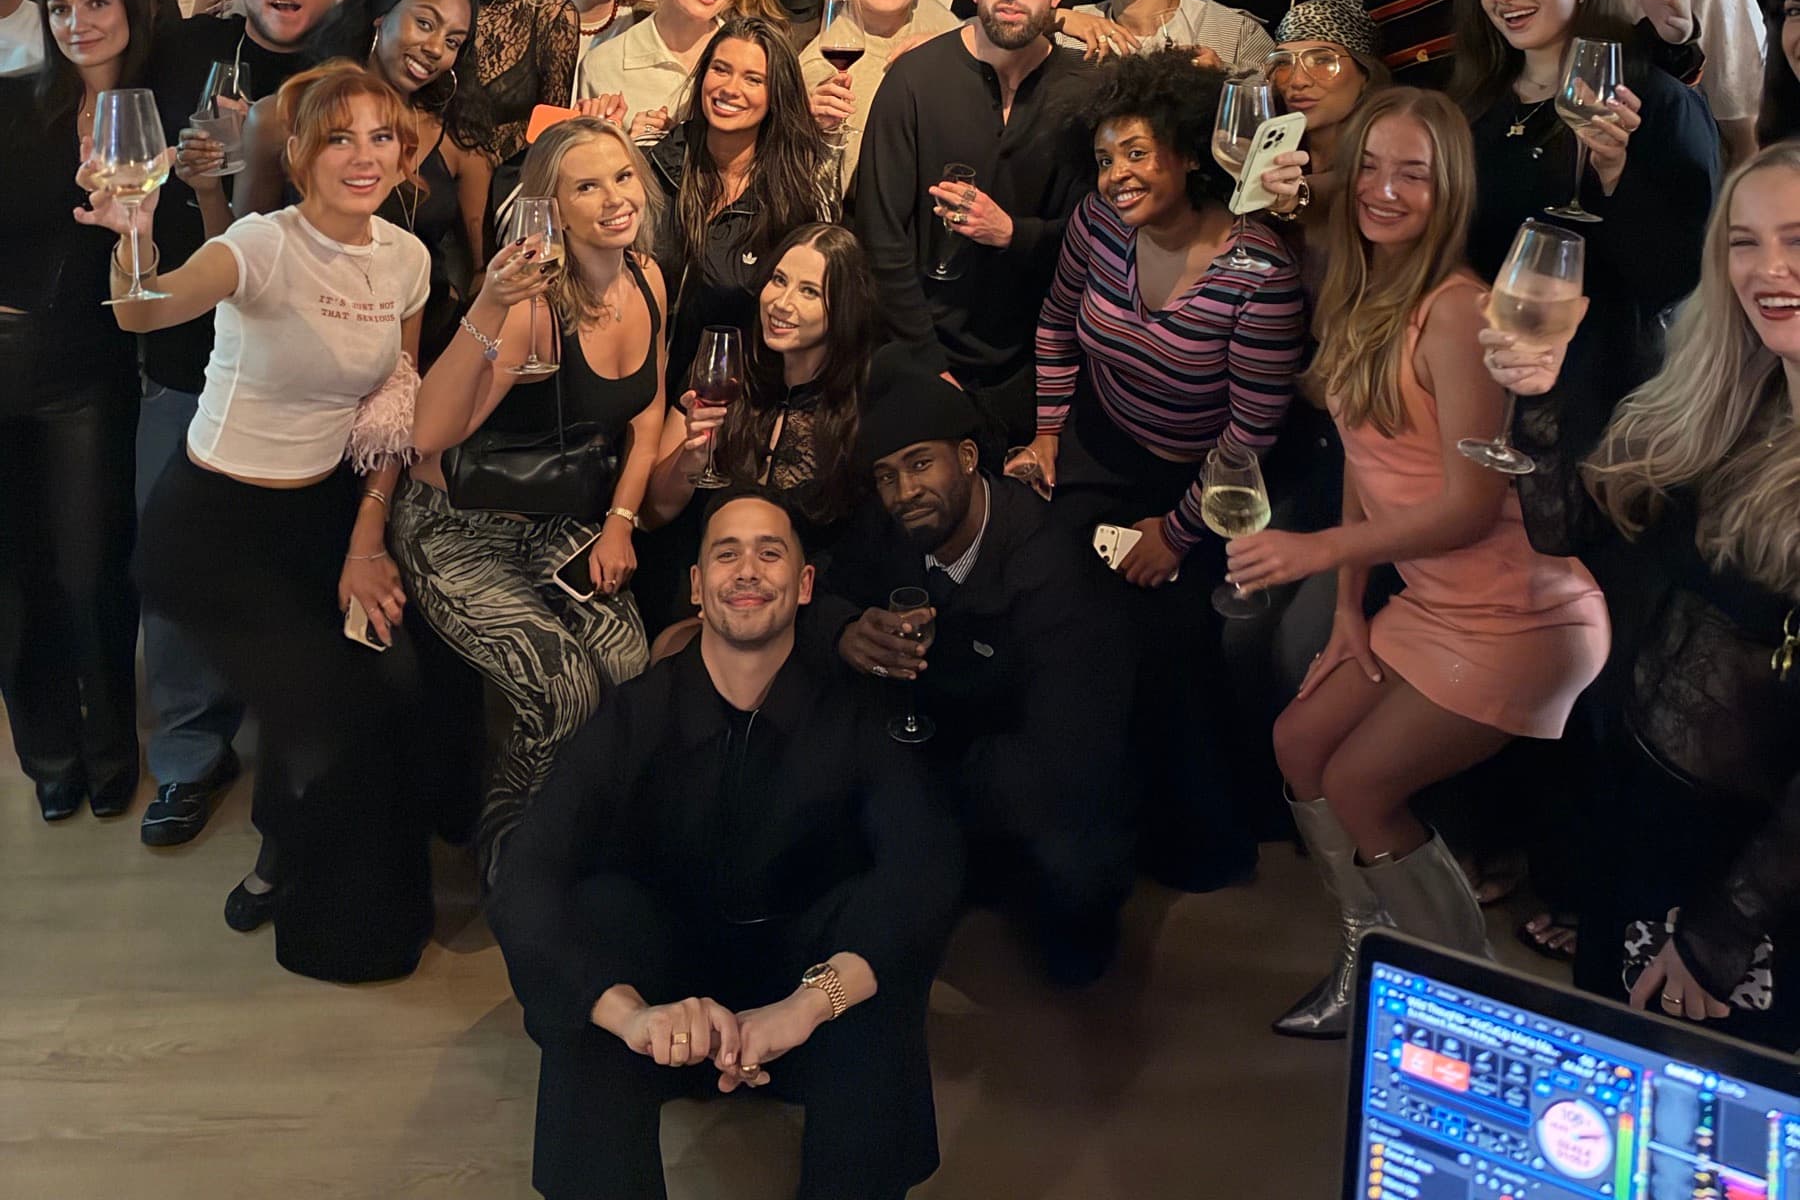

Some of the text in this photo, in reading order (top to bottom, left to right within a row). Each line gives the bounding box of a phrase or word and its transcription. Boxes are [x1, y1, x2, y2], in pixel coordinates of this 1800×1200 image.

[319, 295, 346, 308] IT'S
[379, 300, 395, 311] NOT
[321, 307, 396, 323] THAT SERIOUS
